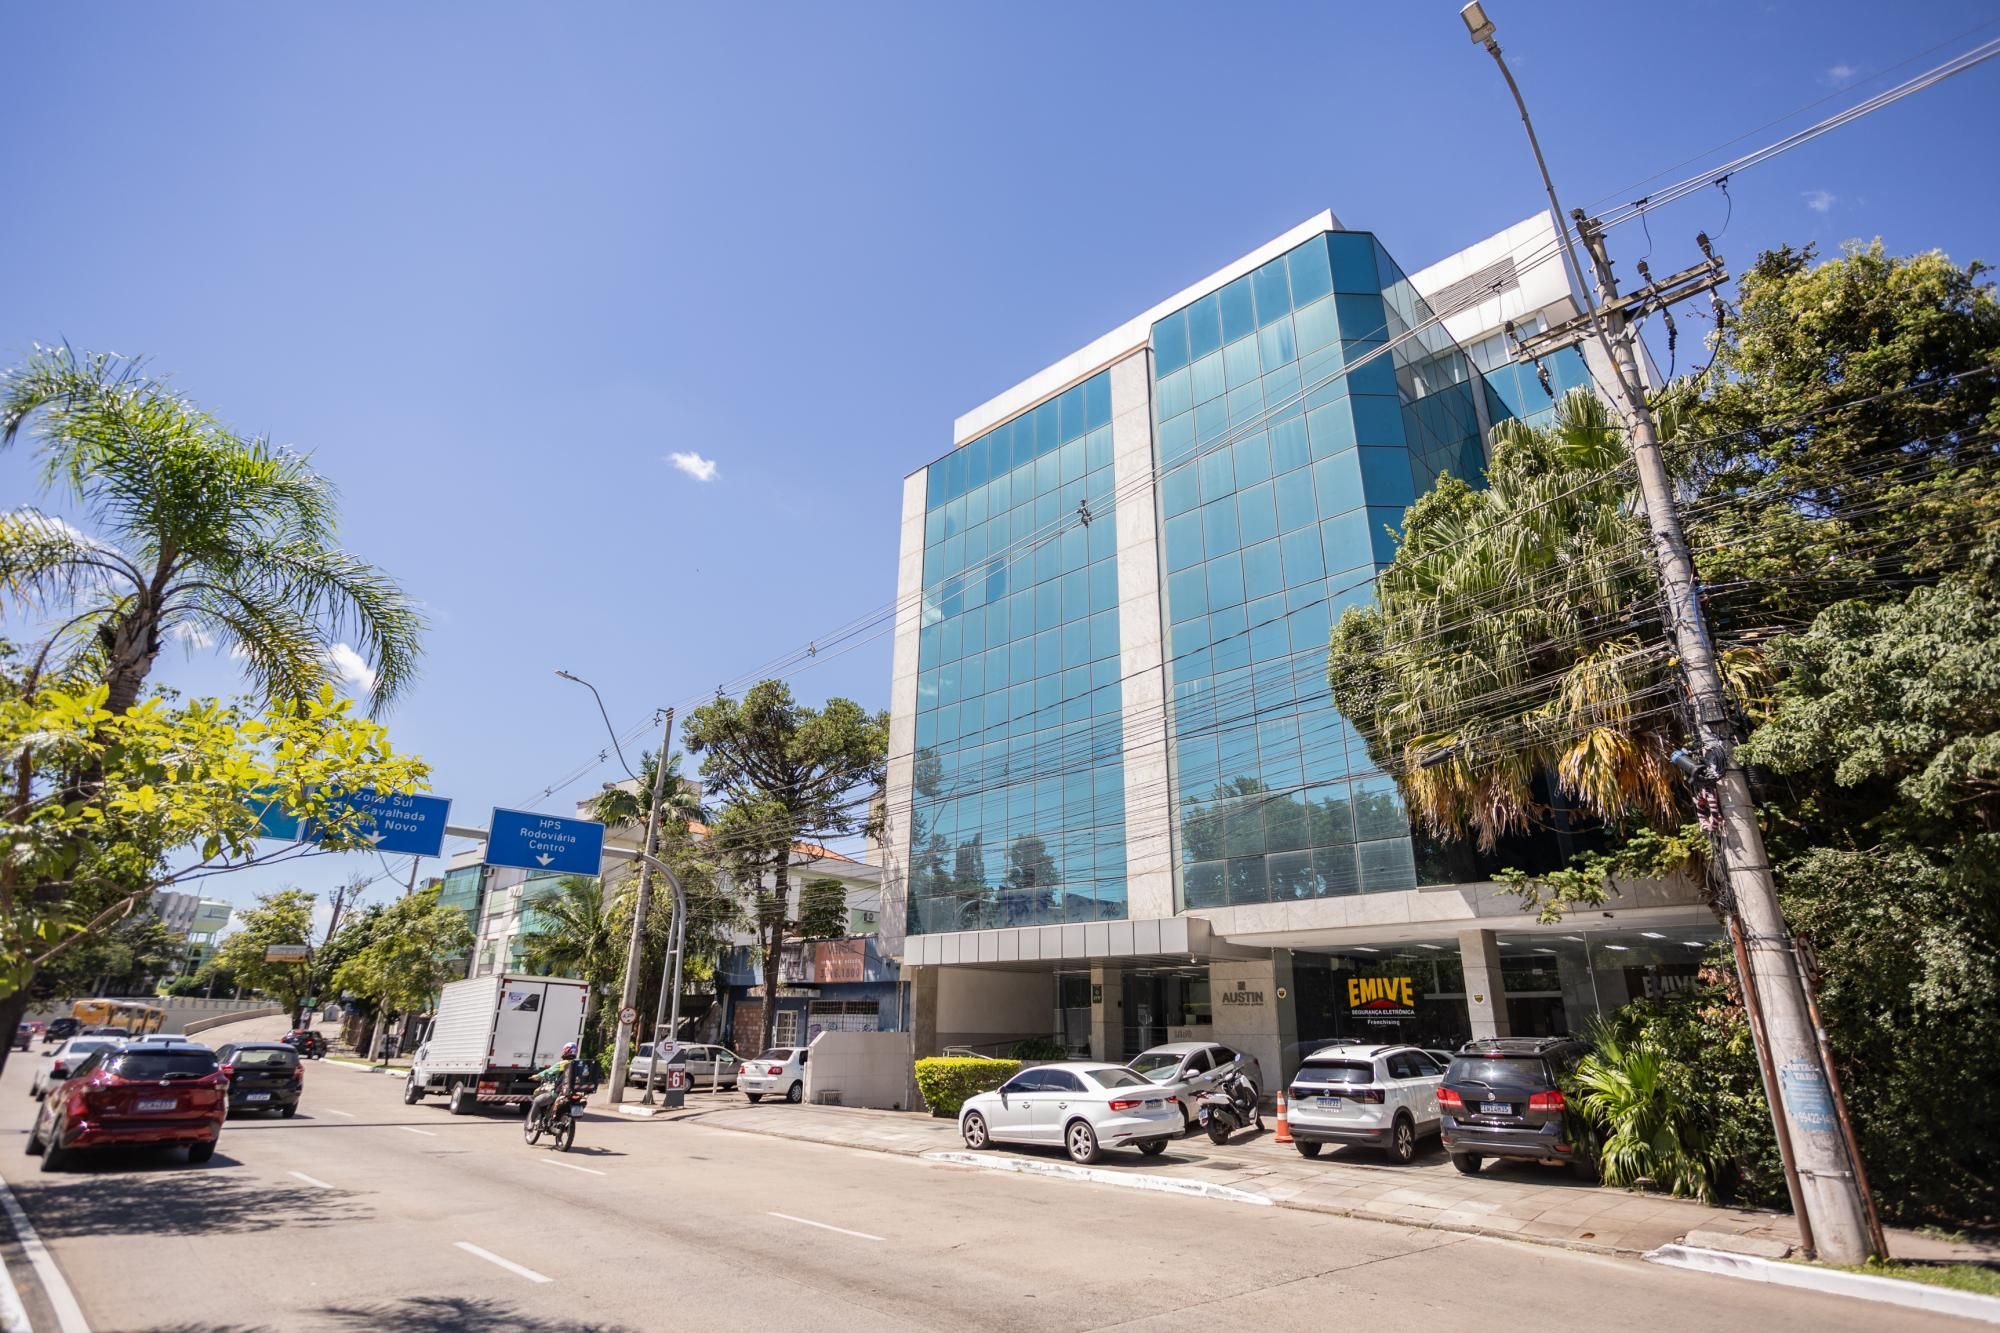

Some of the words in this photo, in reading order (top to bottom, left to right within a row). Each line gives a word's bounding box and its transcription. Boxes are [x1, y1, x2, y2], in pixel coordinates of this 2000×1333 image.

[354, 791, 387, 804] Zona
[393, 797, 413, 808] Sul
[361, 804, 426, 821] Cavalhada
[385, 820, 418, 832] Novo
[540, 819, 561, 830] HPS
[520, 827, 576, 843] Rodoviária
[529, 840, 565, 852] Centro
[1222, 991, 1264, 1003] AUSTIN
[1348, 976, 1415, 1008] EMIVE
[1382, 1008, 1416, 1016] ELETRÔNICA
